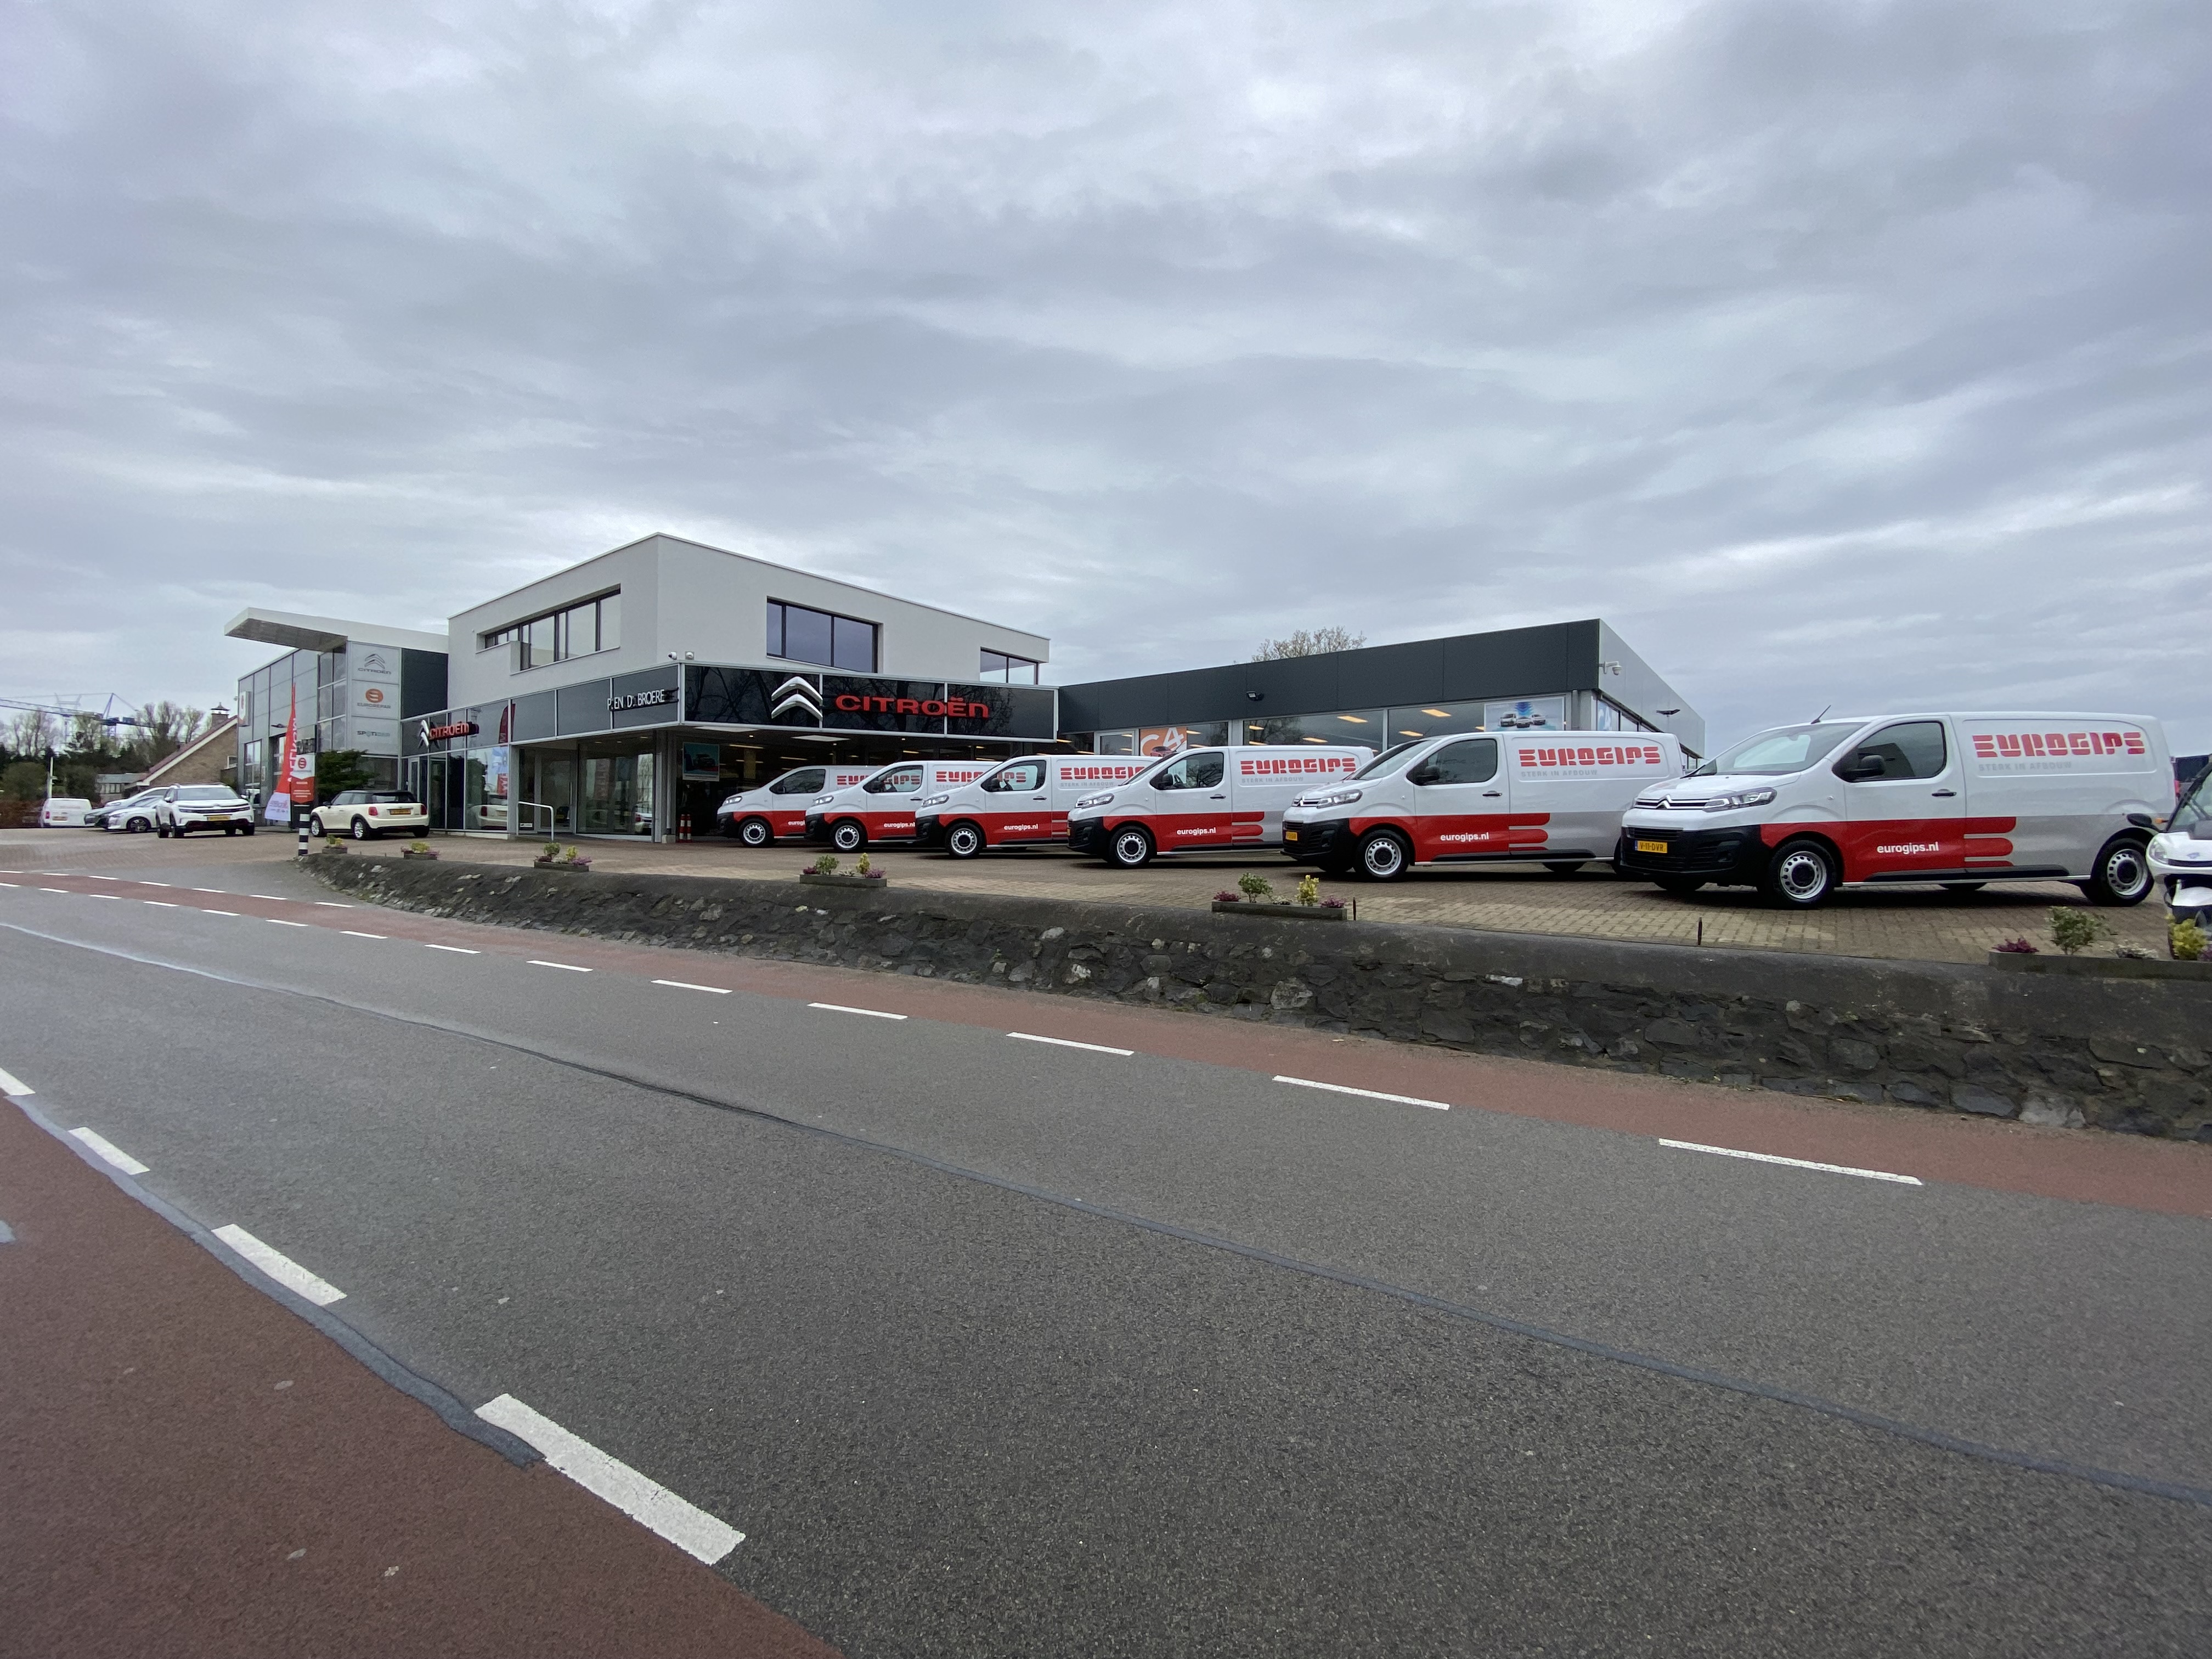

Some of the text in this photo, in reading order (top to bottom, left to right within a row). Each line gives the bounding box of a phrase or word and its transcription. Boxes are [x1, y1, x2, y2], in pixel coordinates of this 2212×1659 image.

[637, 689, 665, 706] BROERE
[1140, 727, 1184, 757] C4
[1972, 732, 2145, 758] EUROGIPS
[1519, 746, 1661, 767] EUROGIPS
[1240, 758, 1357, 775] EUROGIPS
[2030, 761, 2072, 770] AFBOUW
[1177, 827, 1216, 836] eurogips.nl
[1440, 832, 1489, 842] eurogips.nl
[1876, 842, 1939, 854] eurogips.nl
